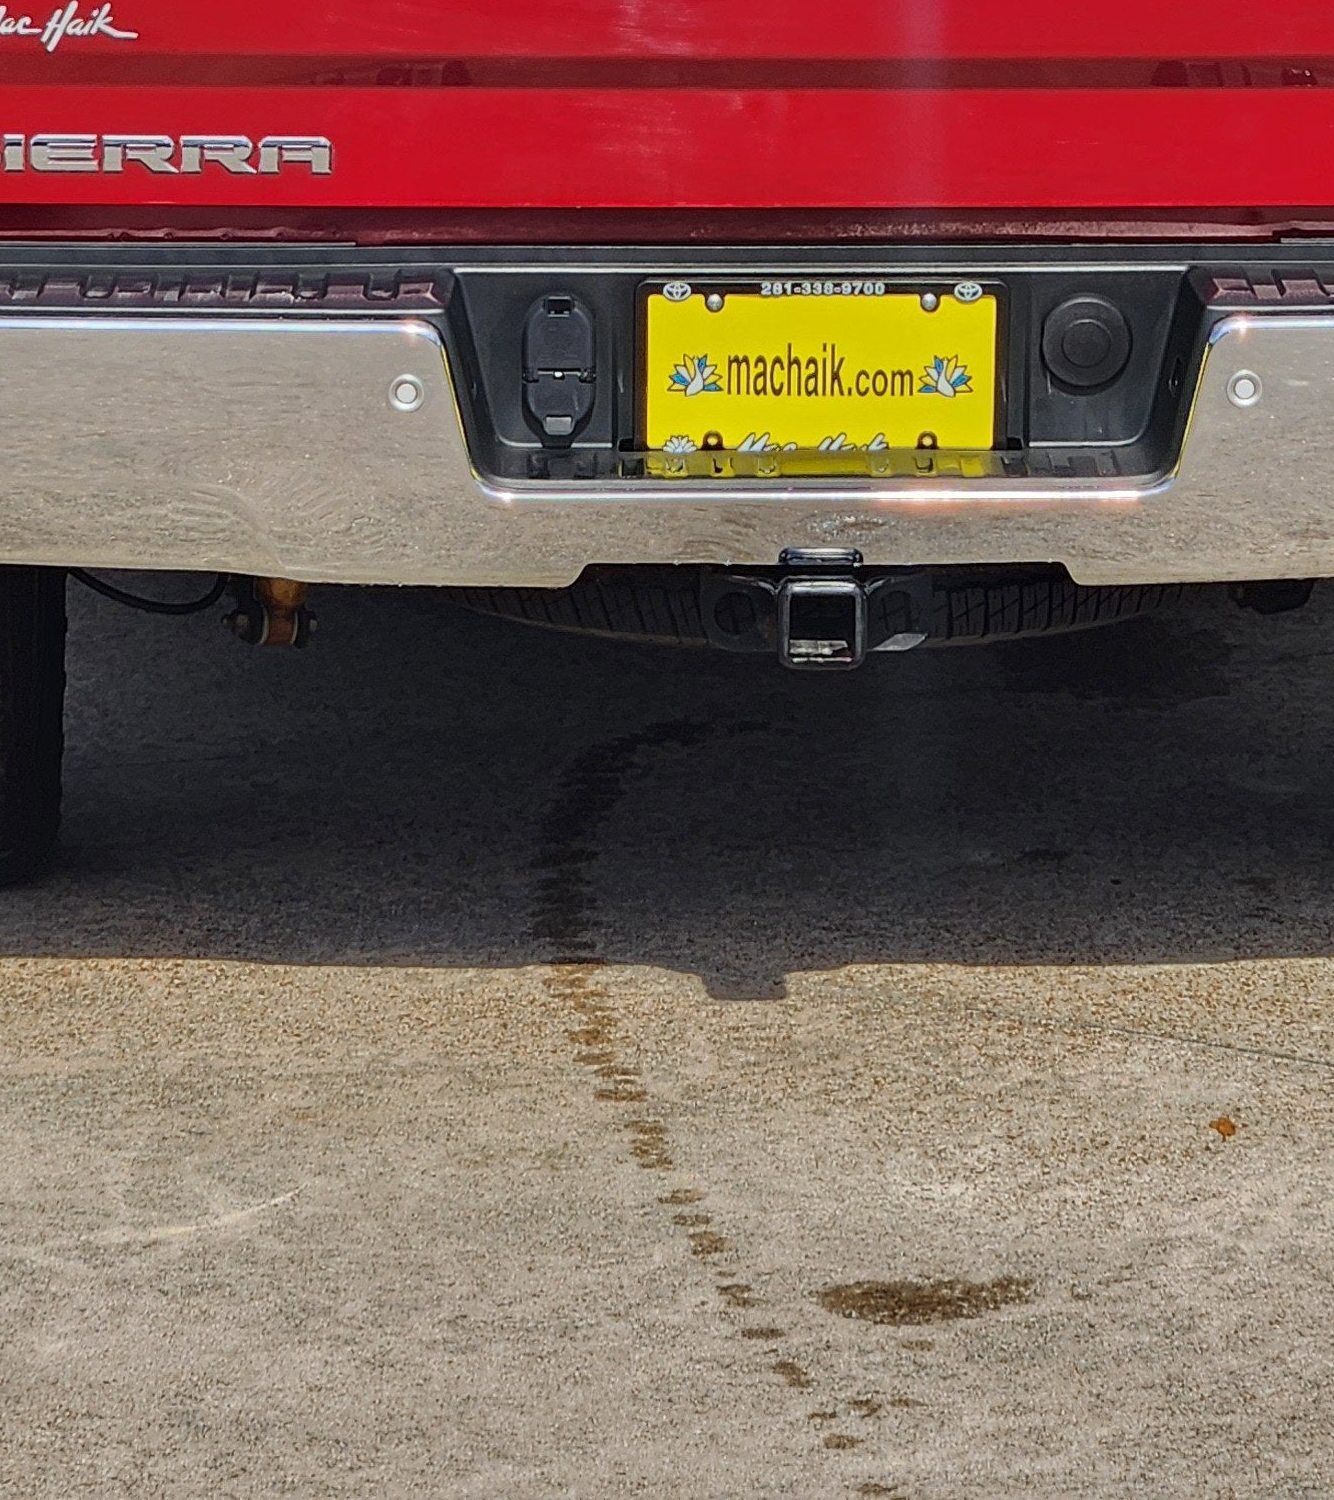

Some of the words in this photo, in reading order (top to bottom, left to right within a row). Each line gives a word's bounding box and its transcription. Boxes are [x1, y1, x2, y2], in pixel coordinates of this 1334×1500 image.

[40, 0, 138, 53] Haik
[760, 282, 885, 297] 281-338-9700
[726, 342, 914, 397] machaik.com
